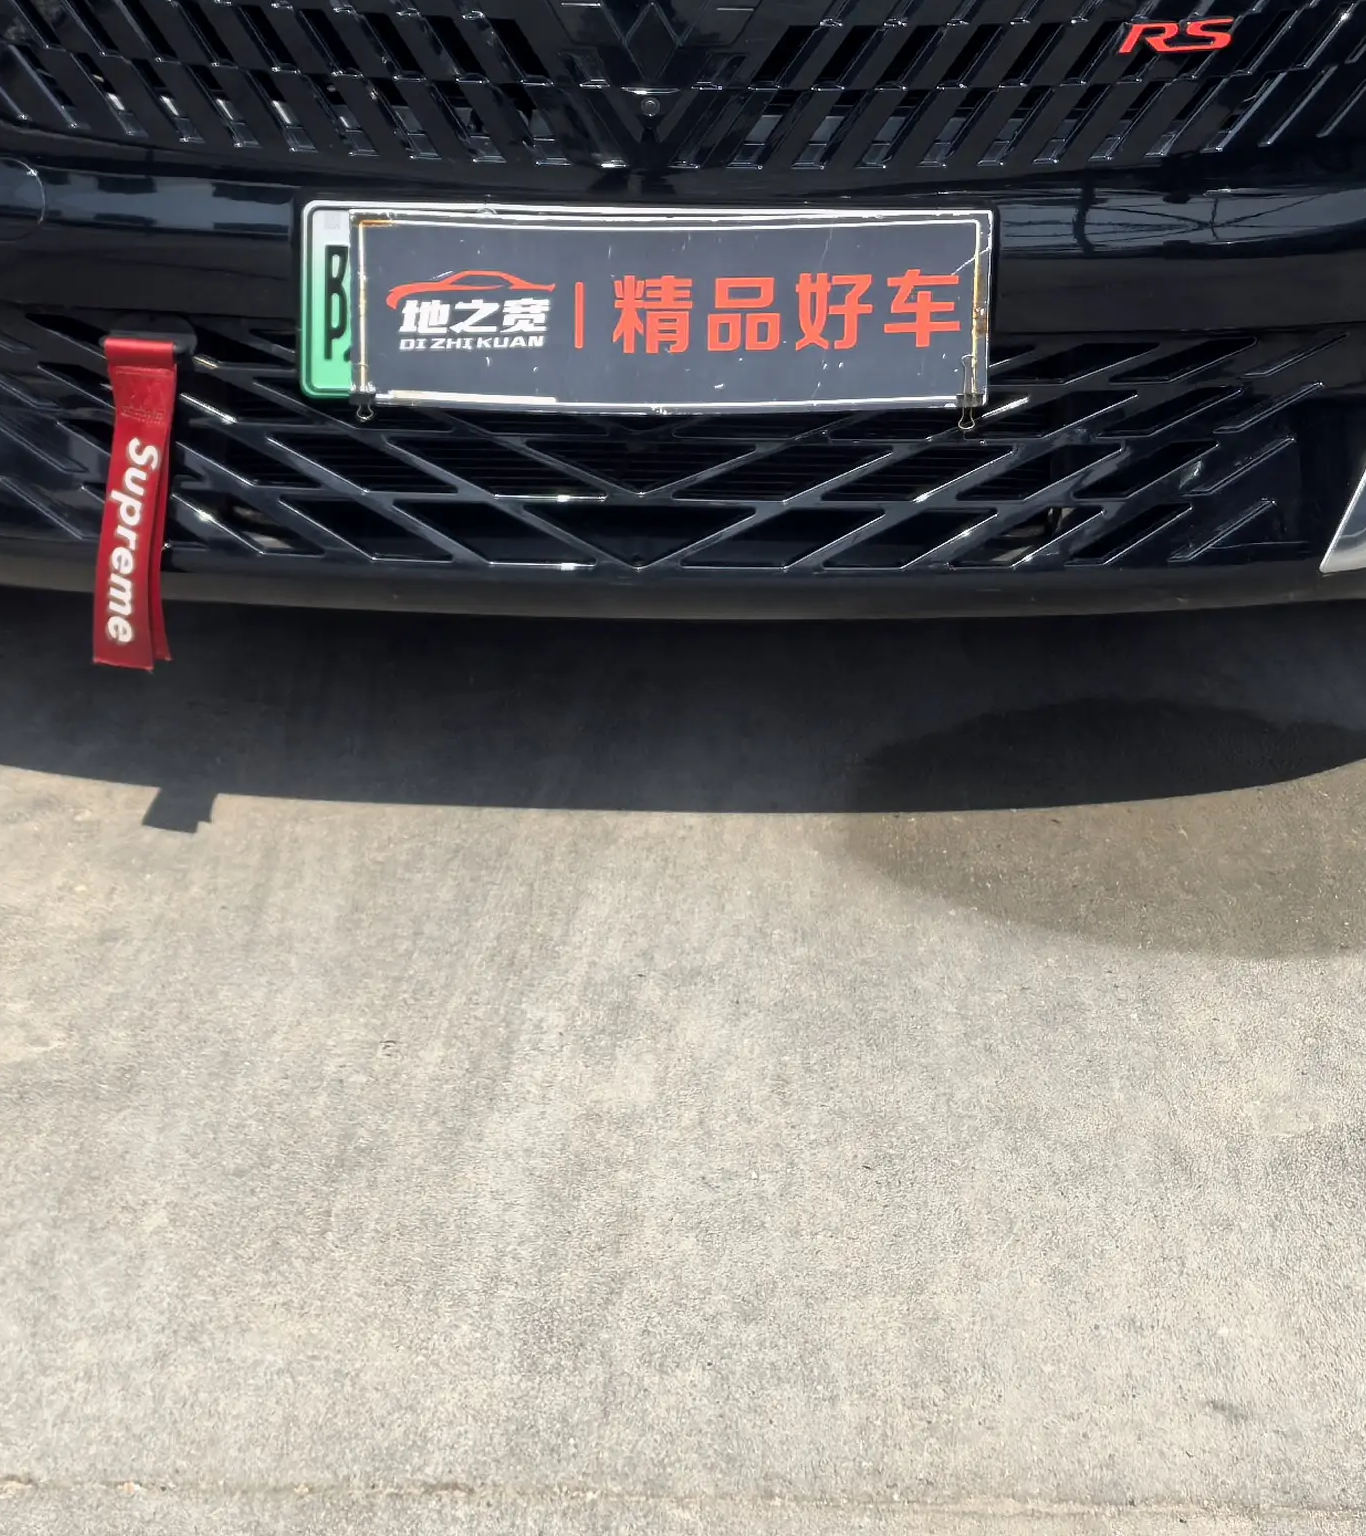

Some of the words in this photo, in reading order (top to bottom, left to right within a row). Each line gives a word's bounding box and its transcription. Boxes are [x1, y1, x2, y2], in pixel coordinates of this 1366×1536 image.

[1118, 18, 1234, 54] RS
[398, 296, 551, 334] 地之宽
[612, 269, 962, 355] 精品好车
[105, 437, 160, 644] Supreme
